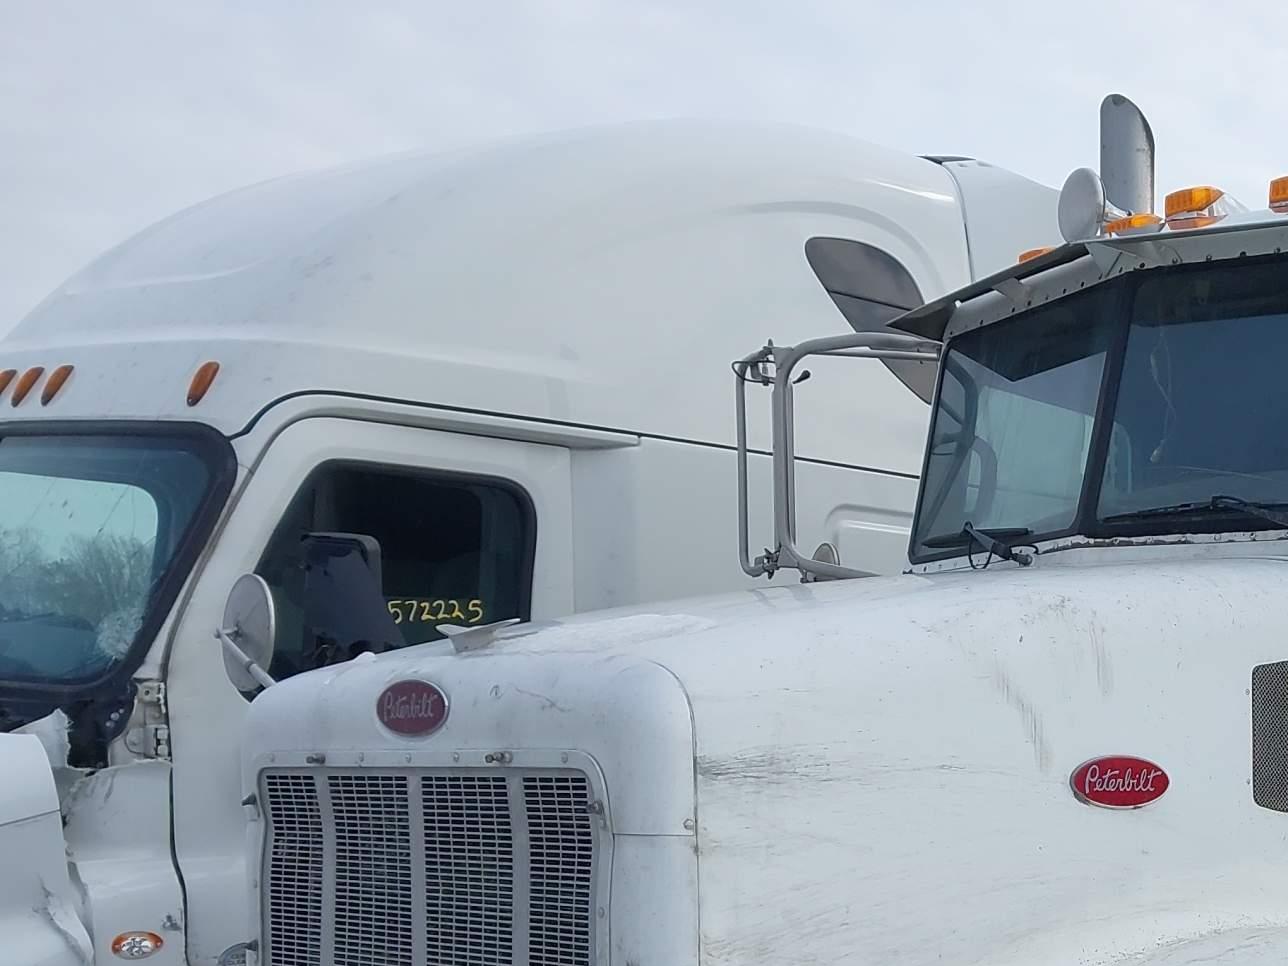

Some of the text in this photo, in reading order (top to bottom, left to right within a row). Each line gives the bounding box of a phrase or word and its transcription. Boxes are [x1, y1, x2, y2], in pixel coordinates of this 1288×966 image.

[387, 599, 483, 624] 572225
[383, 691, 439, 722] Peterbilt
[1084, 764, 1162, 794] Peterbilt
